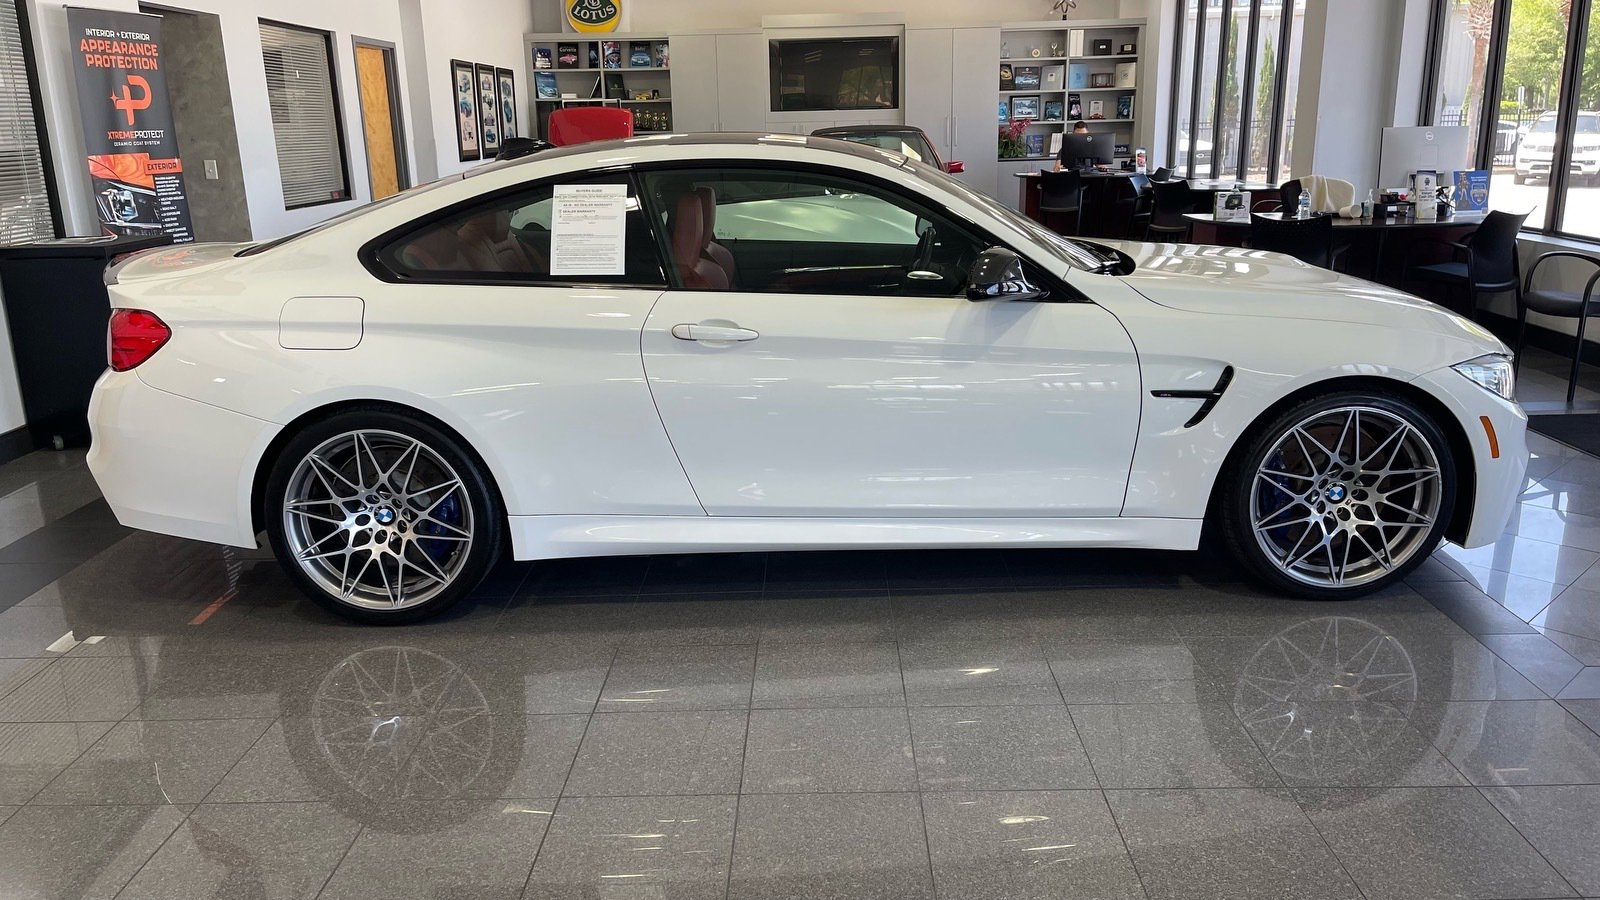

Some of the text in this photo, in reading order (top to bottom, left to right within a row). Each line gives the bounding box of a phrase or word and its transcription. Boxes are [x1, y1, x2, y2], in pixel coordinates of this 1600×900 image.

[573, 5, 615, 20] LOTUS
[85, 28, 115, 38] INTERIOR
[121, 31, 151, 41] EXTERIOR
[80, 38, 159, 57] APPEARANCE
[85, 54, 158, 71] PROTECTION
[107, 130, 164, 140] XTREMEPROTECT
[147, 162, 177, 171] EXTERIOR
